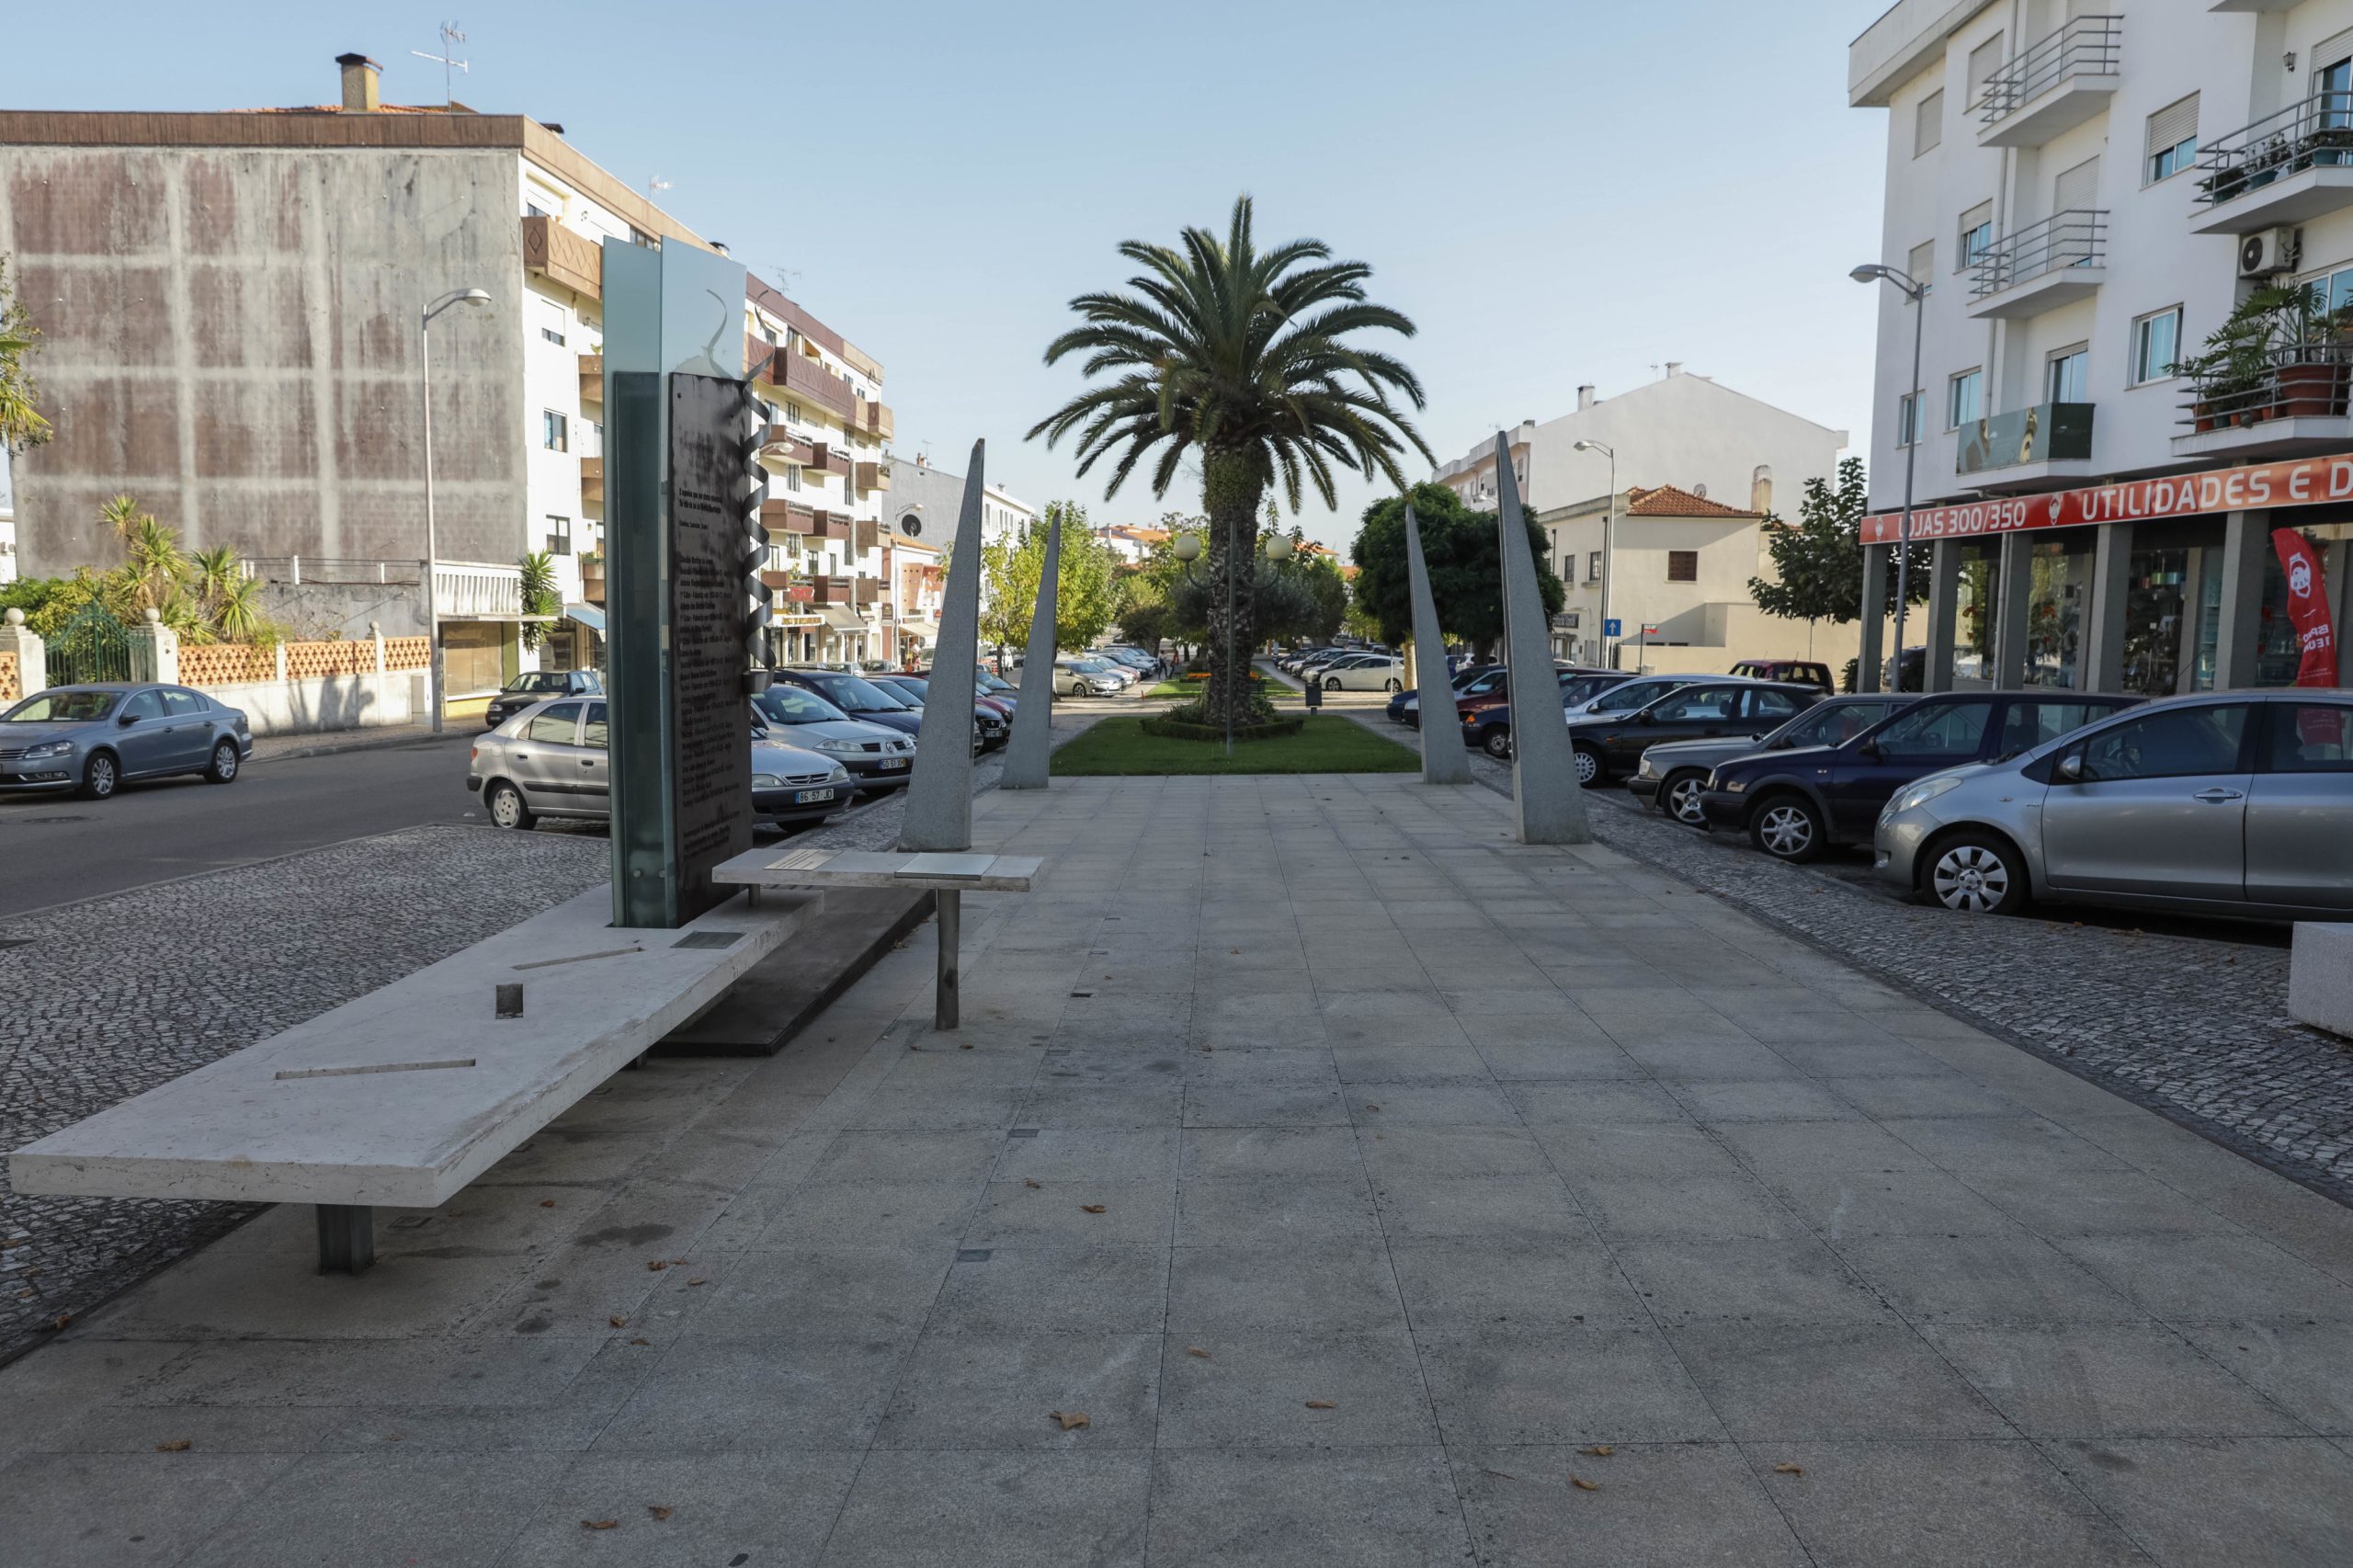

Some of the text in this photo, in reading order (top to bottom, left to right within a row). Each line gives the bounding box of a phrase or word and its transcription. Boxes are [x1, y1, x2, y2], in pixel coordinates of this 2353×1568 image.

[2082, 470, 2271, 521] UTILIDADES
[2289, 465, 2312, 499] E
[1949, 501, 2027, 533] 300/350
